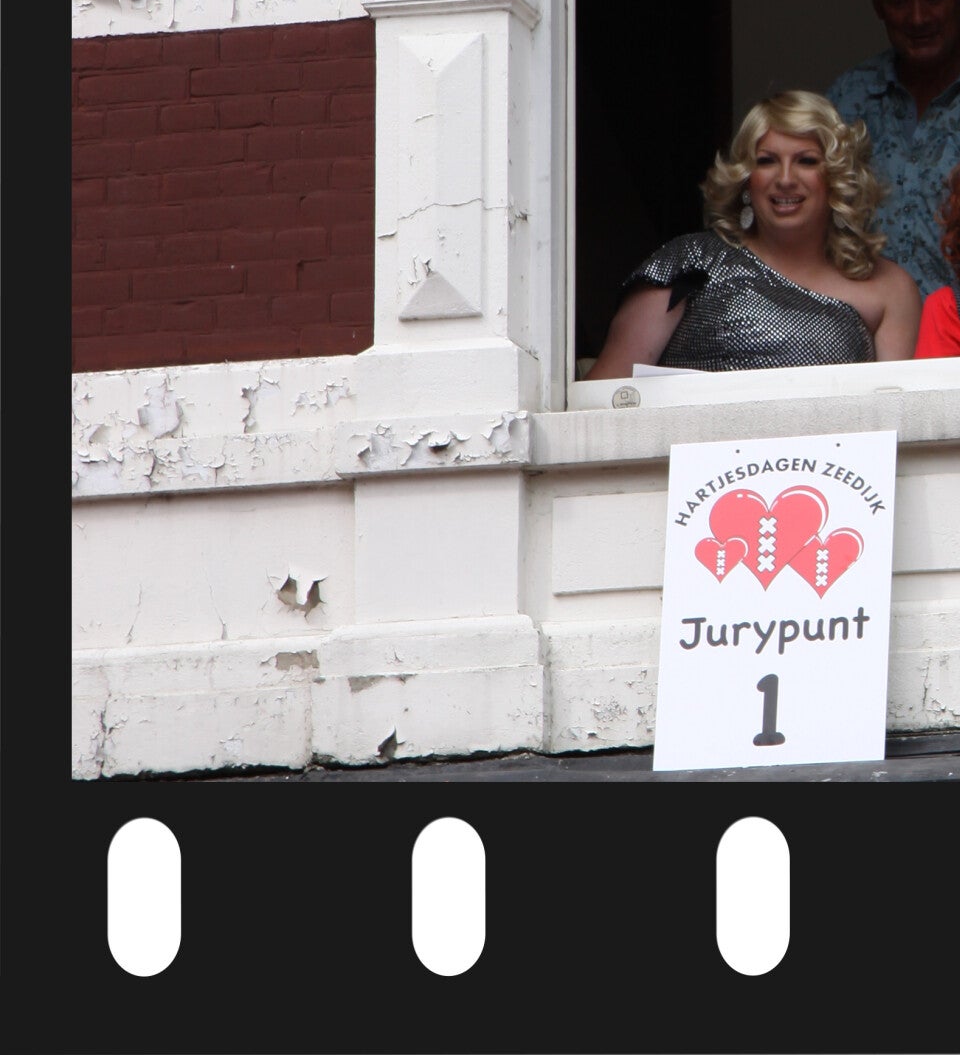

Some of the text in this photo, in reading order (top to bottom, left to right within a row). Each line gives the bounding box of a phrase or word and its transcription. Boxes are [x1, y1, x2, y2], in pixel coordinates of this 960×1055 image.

[674, 458, 887, 527] HARTJESDAGEN ZEEDIJK
[679, 606, 871, 655] Jurypunt
[752, 673, 786, 747] 1
